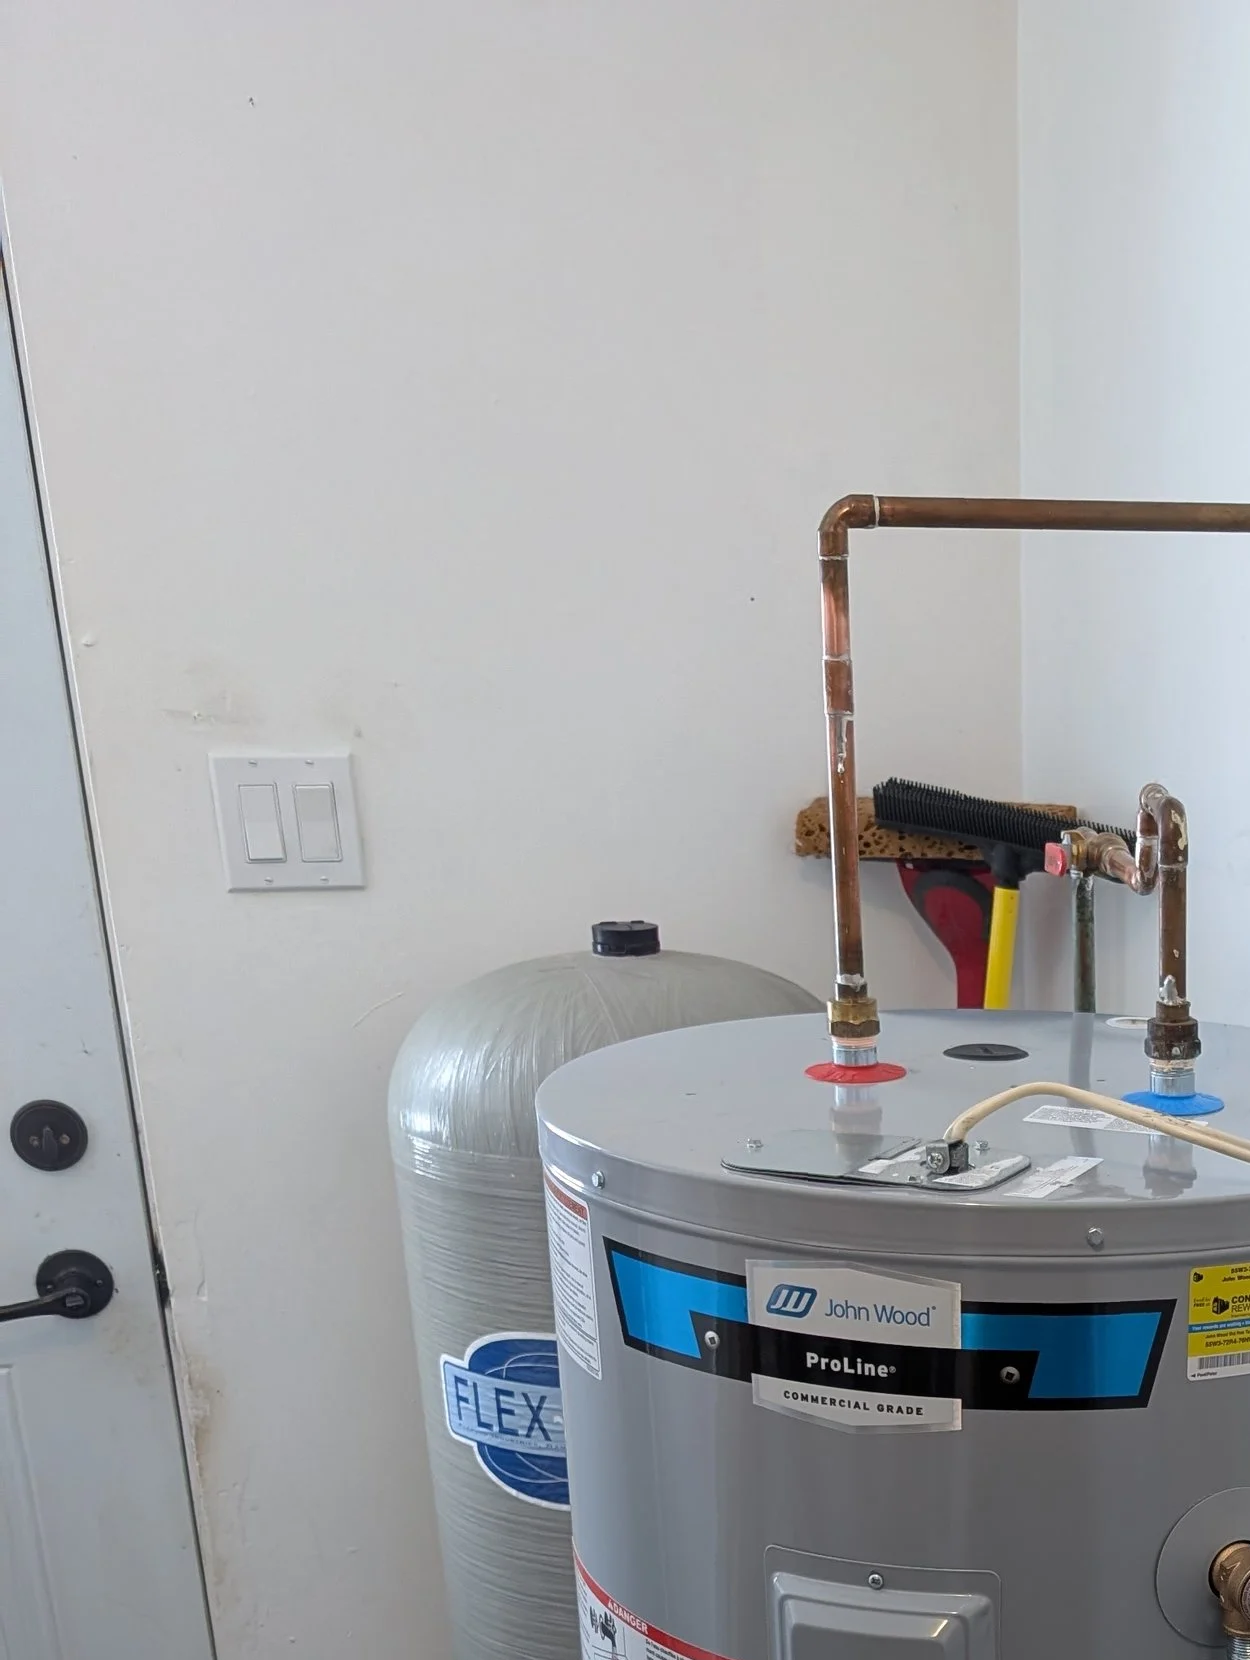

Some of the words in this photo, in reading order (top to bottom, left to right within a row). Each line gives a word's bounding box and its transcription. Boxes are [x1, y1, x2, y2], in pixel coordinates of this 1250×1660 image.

[825, 1299, 870, 1322] John
[784, 1390, 870, 1411] COMMERCIAL
[877, 1404, 924, 1416] GRADE
[613, 1604, 648, 1635] DANGER
